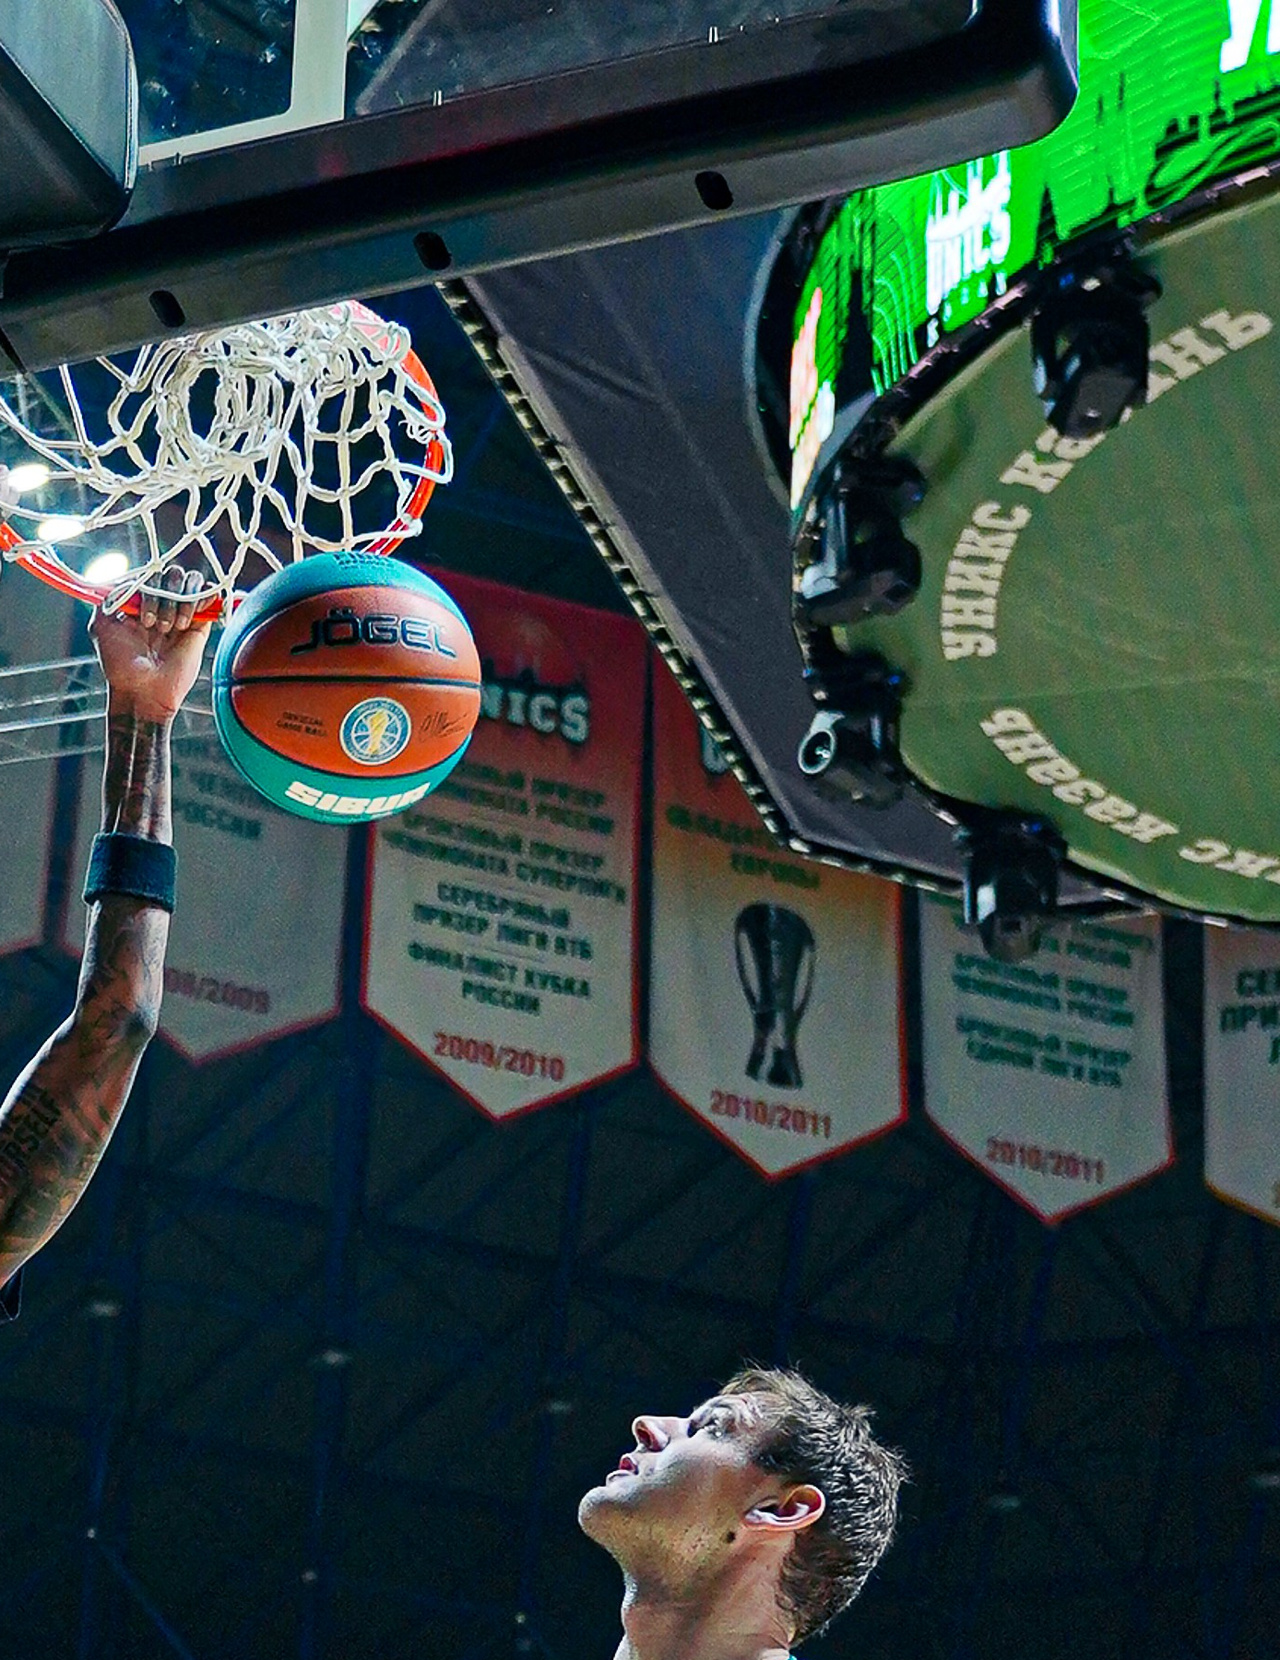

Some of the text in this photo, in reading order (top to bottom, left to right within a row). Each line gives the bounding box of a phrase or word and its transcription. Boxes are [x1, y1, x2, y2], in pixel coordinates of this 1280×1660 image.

[291, 607, 457, 658] JÖGEL
[481, 683, 591, 742] NICS
[285, 781, 431, 816] SIBUR
[433, 1031, 566, 1083] 2009/2010
[709, 1088, 832, 1140] 2010/2011
